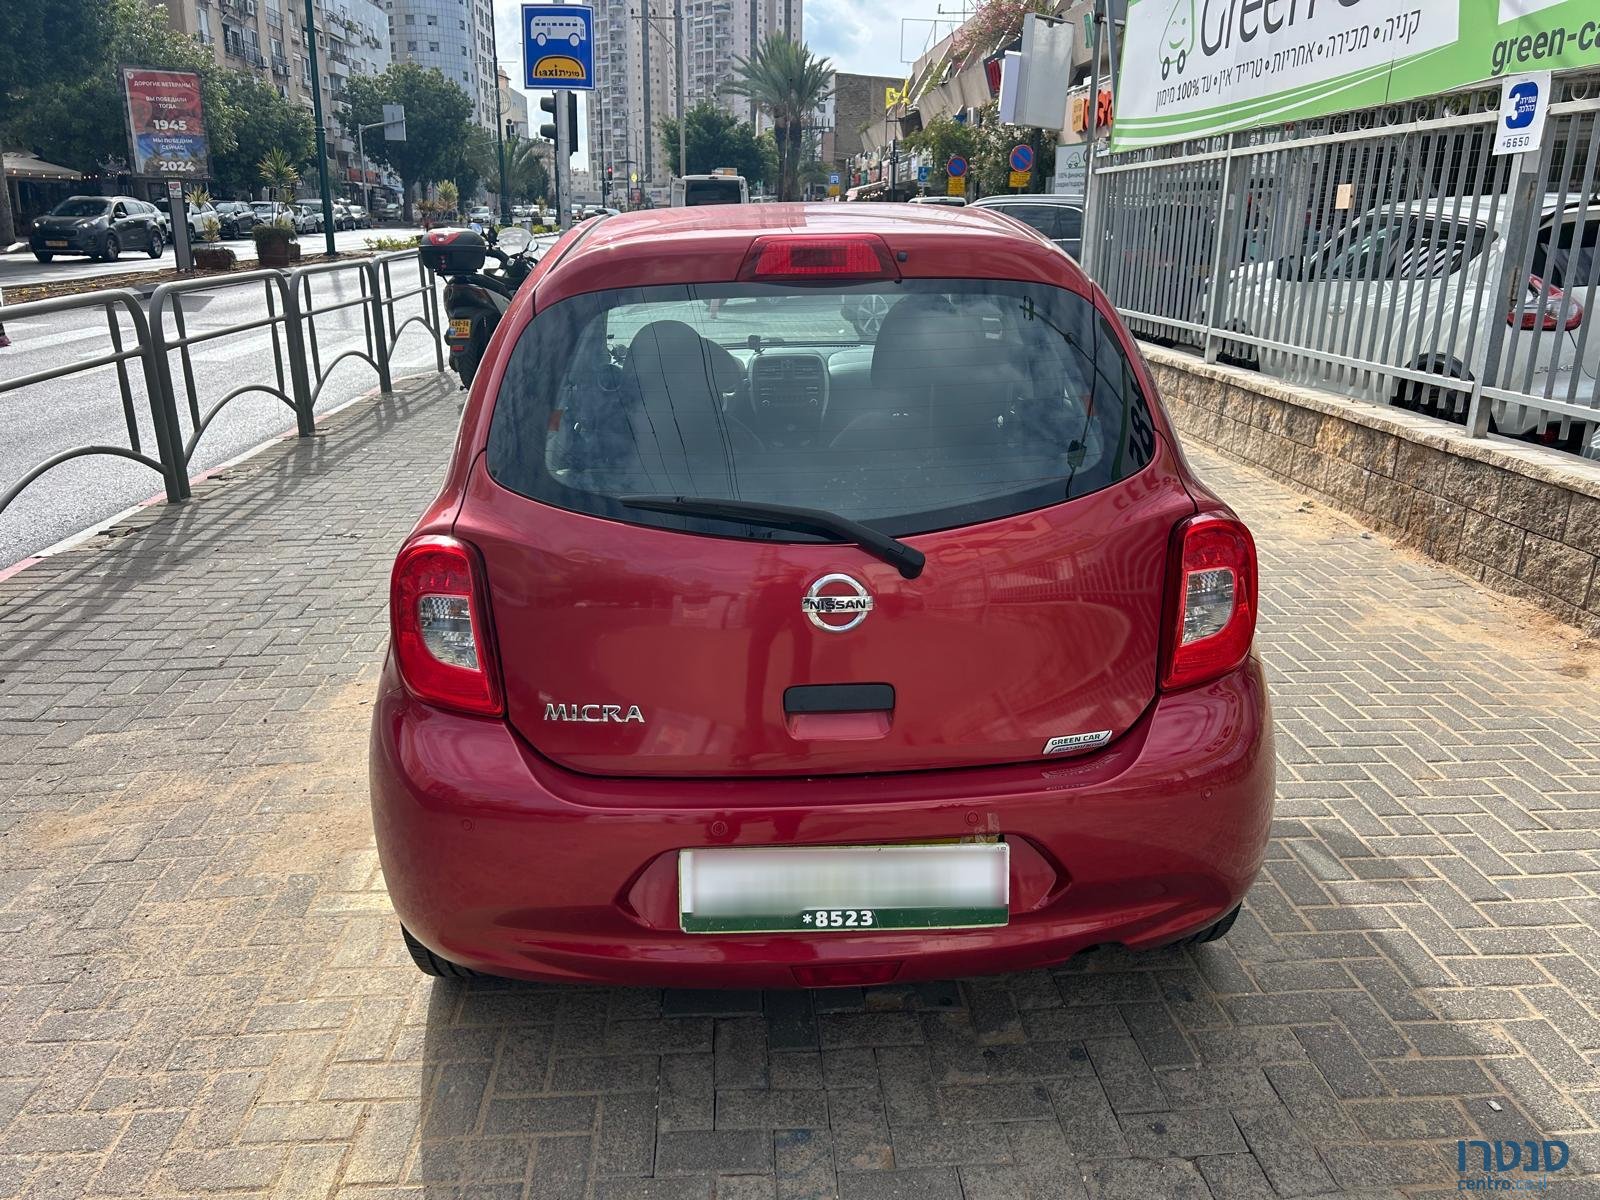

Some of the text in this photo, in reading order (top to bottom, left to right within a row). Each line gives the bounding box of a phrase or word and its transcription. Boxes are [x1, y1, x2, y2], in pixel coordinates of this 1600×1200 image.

[1155, 9, 1421, 112] קניה מכירה אחריות טרייד אין עד 100% מימון
[539, 64, 558, 77] taxi
[558, 69, 580, 78] מונית
[1519, 96, 1537, 105] שמירה
[153, 119, 187, 131] 1945
[159, 161, 196, 172] 2024
[808, 598, 867, 611] NISSAN
[543, 703, 645, 723] MICRA
[1051, 733, 1101, 746] GREEN CAR
